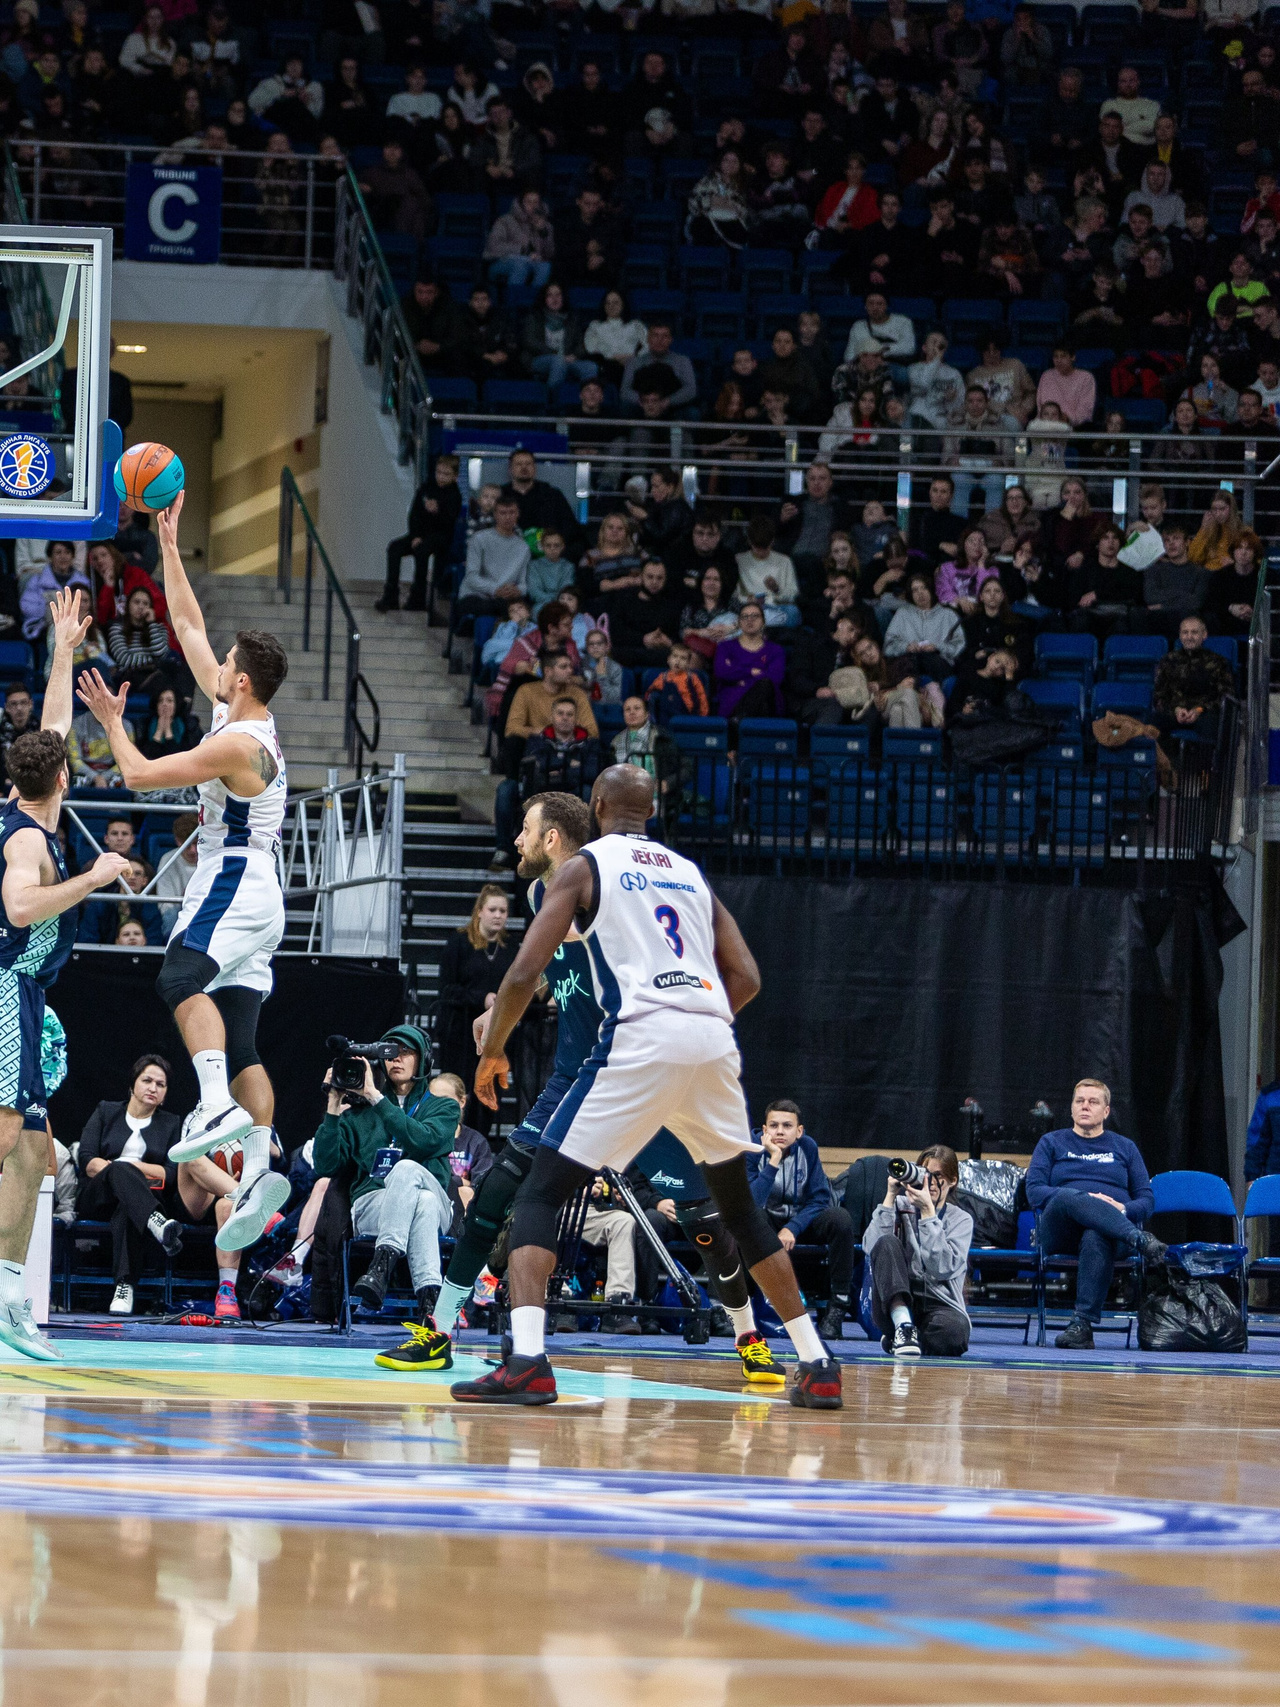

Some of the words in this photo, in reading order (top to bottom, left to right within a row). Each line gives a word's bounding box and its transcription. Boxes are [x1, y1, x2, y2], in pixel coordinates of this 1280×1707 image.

[153, 168, 197, 180] TRIBUNE
[148, 182, 199, 244] C
[23, 434, 41, 445] ЛИГА
[39, 442, 51, 455] ВТБ
[5, 485, 28, 497] UNITED
[28, 477, 51, 497] LEAGUE
[631, 848, 673, 868] JEKIRI
[654, 904, 684, 959] 3
